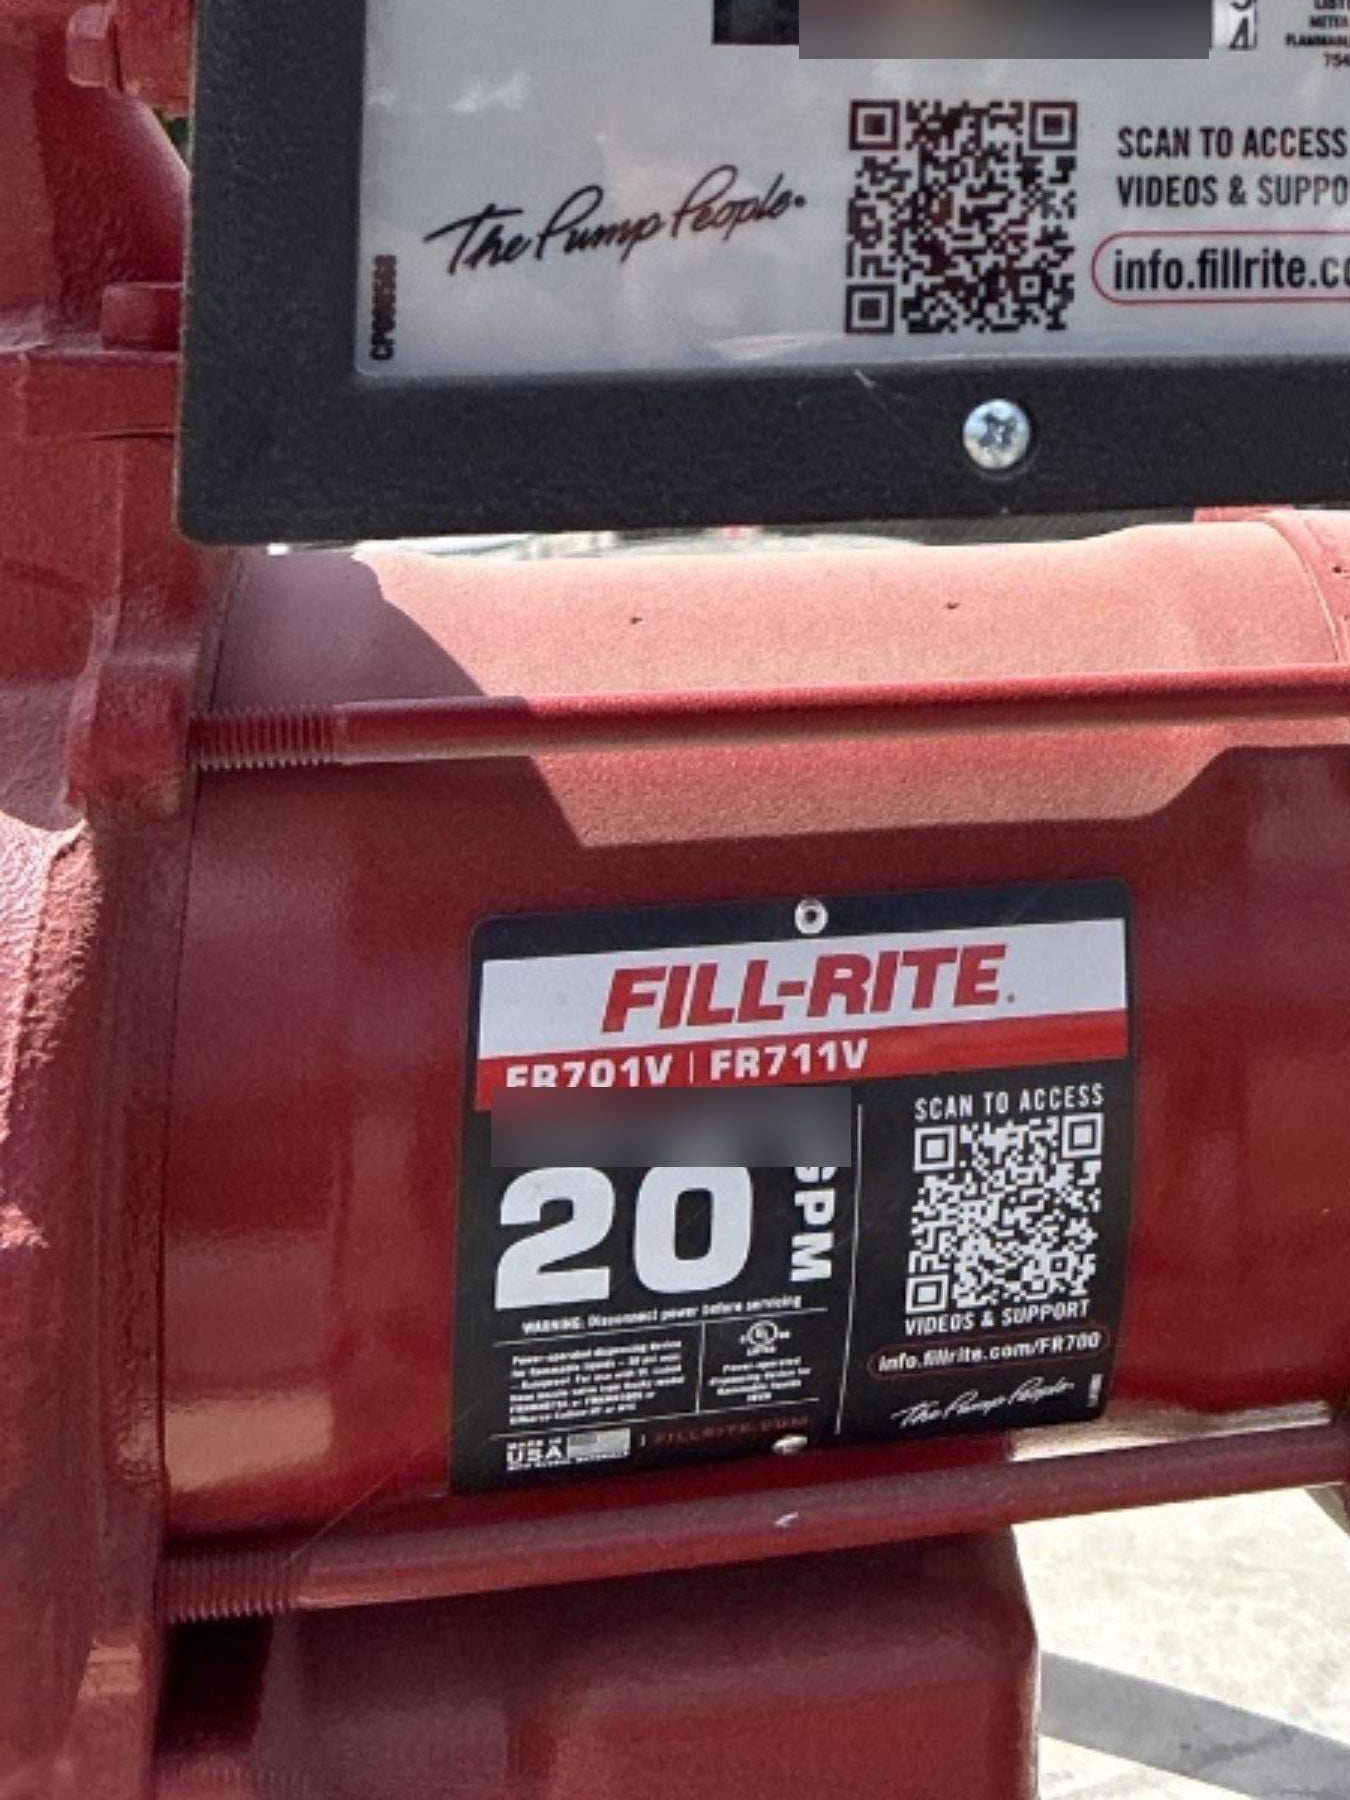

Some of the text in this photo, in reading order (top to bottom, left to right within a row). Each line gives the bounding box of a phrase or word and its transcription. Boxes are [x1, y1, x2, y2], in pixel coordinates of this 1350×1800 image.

[1308, 15, 1348, 29] METER
[1117, 126, 1348, 158] SCAN TO ACCESS
[1116, 175, 1219, 207] VIDEOS
[1228, 176, 1249, 207] &
[423, 203, 534, 275] The
[531, 185, 665, 262] Pump
[505, 1037, 869, 1088] FR701V FR711V
[914, 1082, 1105, 1122] SCAN TO ACCESS
[495, 1167, 753, 1312] 20
[904, 1299, 1090, 1336] VIDEOS & SUPPORT
[877, 1331, 1101, 1373] info.fillrite.com/FR700
